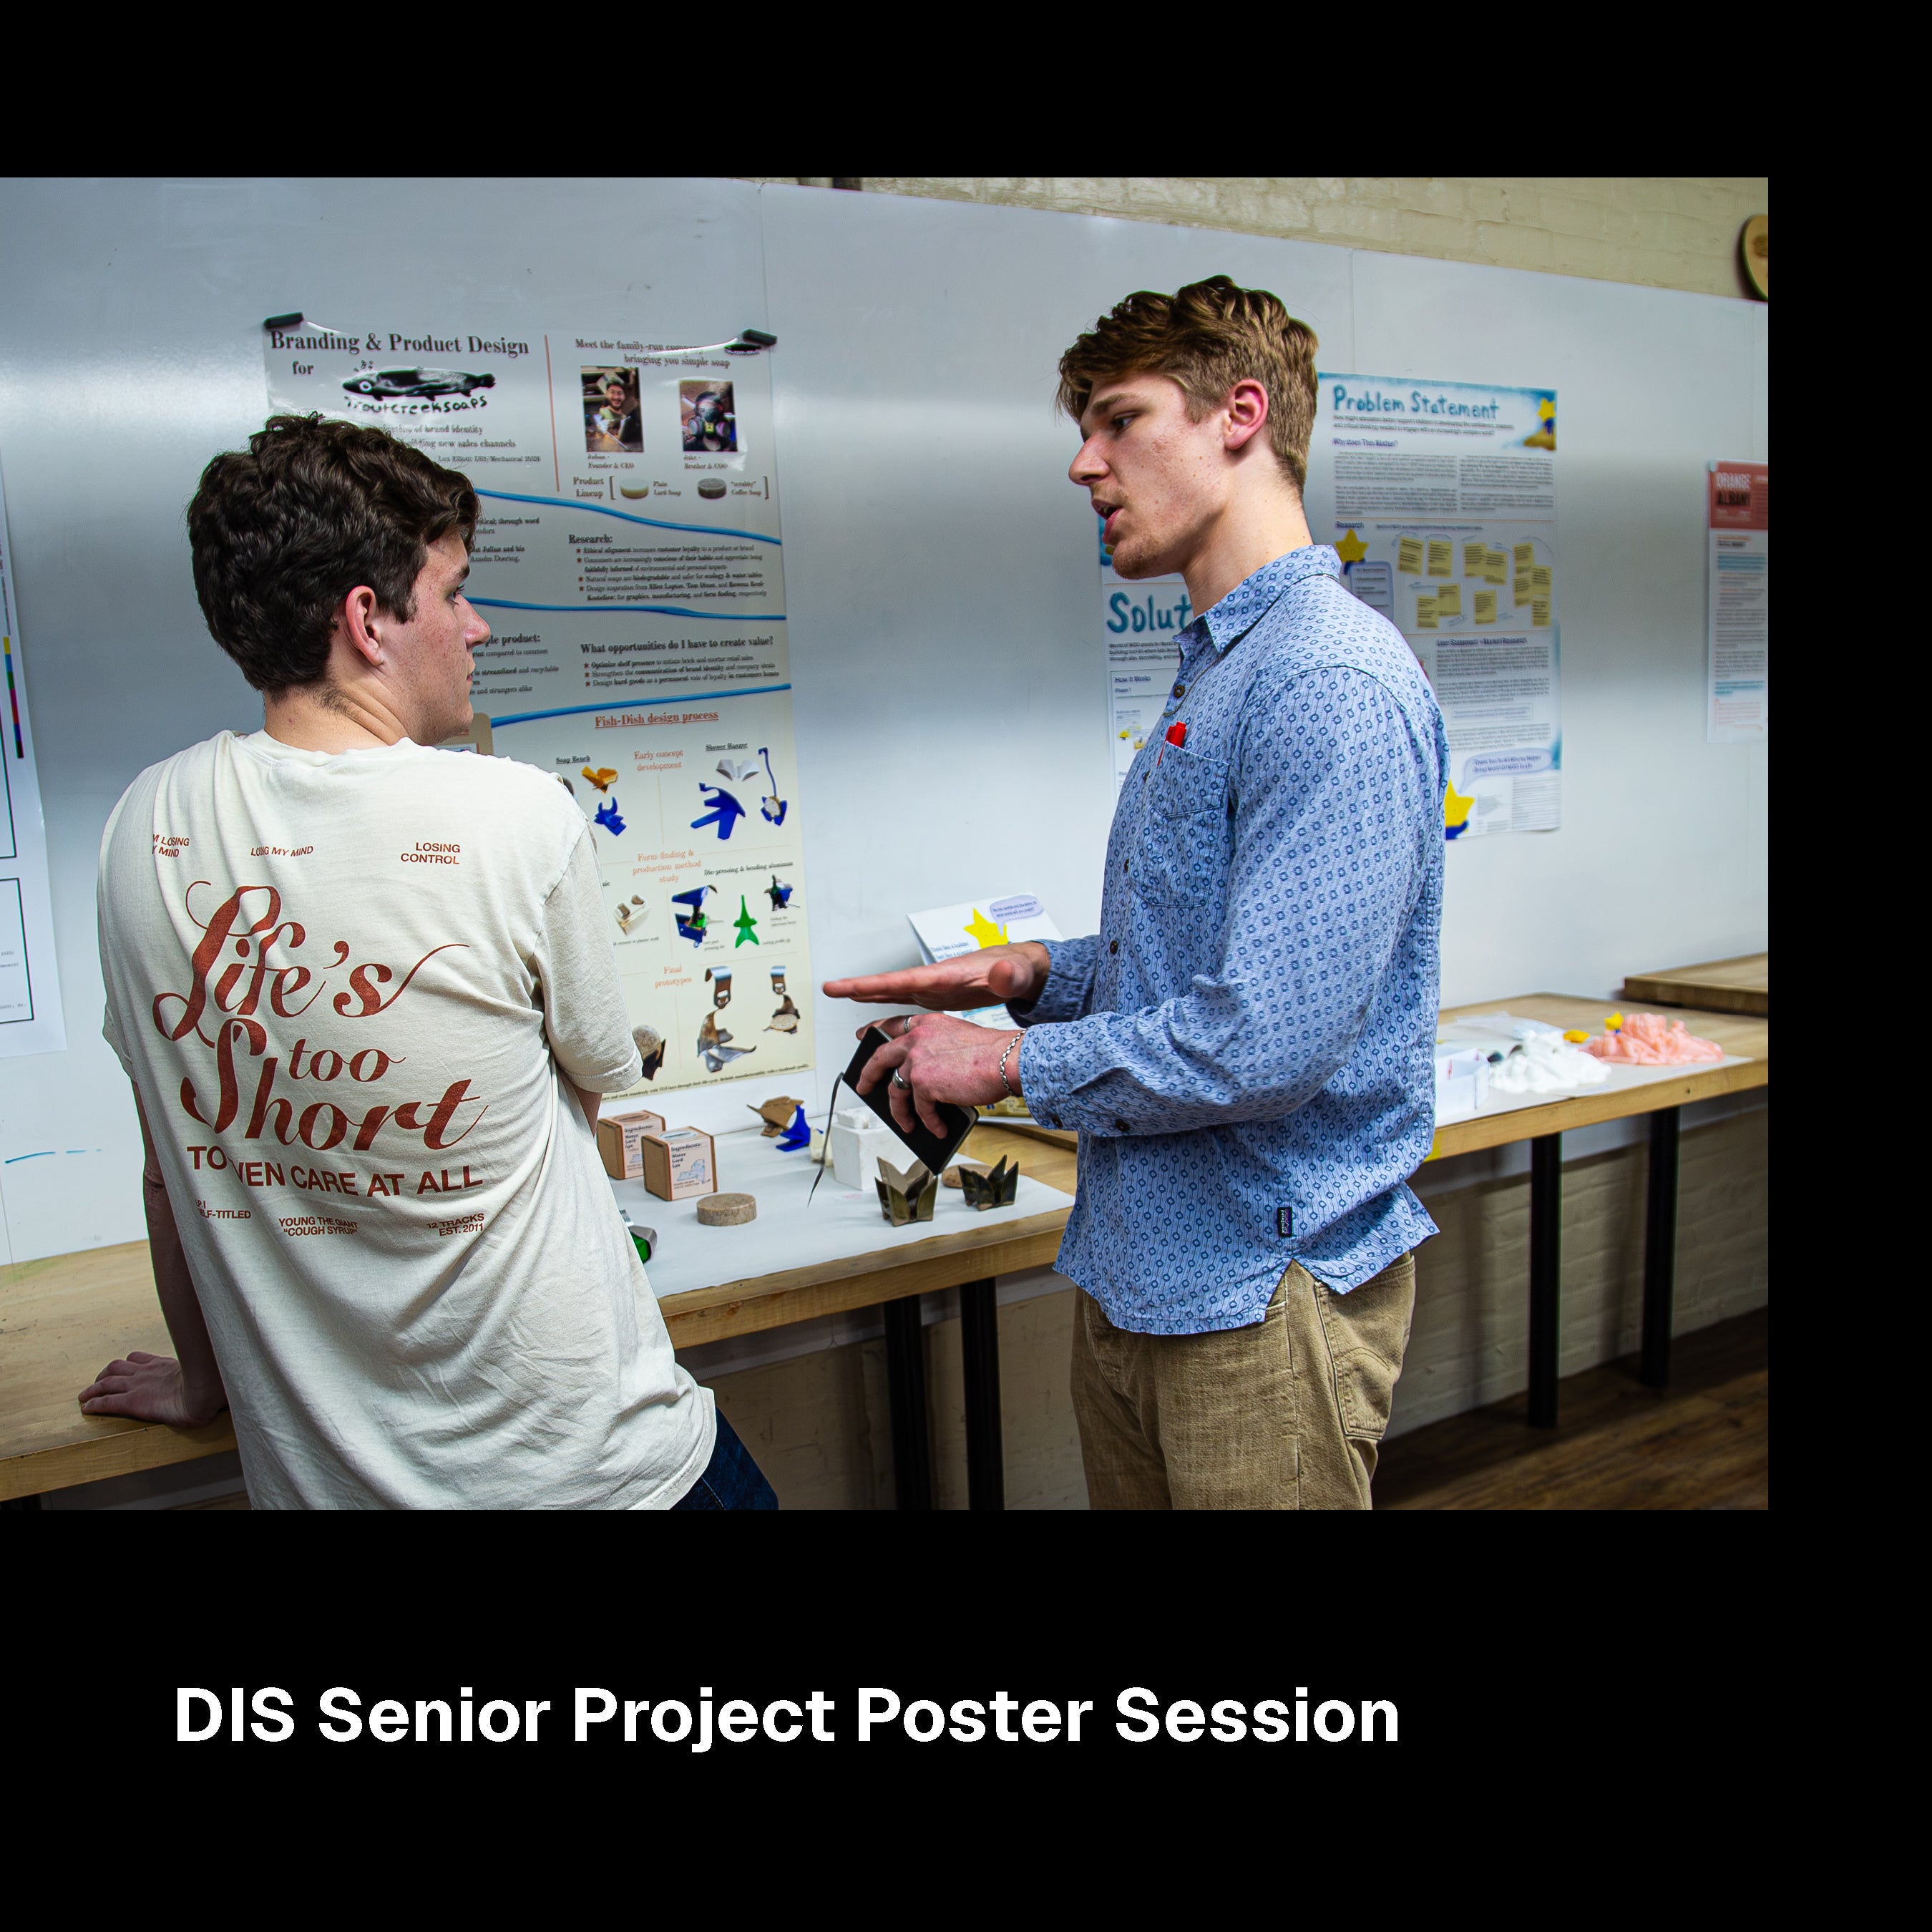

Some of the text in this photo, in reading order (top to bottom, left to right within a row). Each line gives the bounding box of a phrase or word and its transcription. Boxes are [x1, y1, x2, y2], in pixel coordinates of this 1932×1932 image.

[270, 331, 530, 358] Branding & Product Design
[575, 338, 598, 349] Meet
[600, 339, 614, 349] the
[616, 340, 664, 352] family-run
[292, 361, 314, 375] for
[624, 353, 731, 369] bringing you simple soap
[1332, 384, 1500, 419] Problem Statement
[458, 439, 479, 448] sales
[480, 439, 517, 448] channels
[572, 476, 605, 485] Product
[576, 488, 603, 499] Lineup
[568, 533, 613, 544] Research:
[1106, 591, 1194, 634] Solut
[485, 633, 541, 647] ple product:
[580, 643, 606, 653] What
[608, 640, 667, 654] opportunities
[668, 640, 679, 649] do
[688, 639, 708, 648] have
[708, 638, 718, 648] to
[719, 637, 746, 647] create
[748, 635, 774, 645] value?
[594, 711, 718, 728] Fish-Dish design process
[633, 749, 684, 761] Early concept
[636, 761, 682, 772] development
[160, 834, 190, 847] LOSING
[416, 841, 461, 854] LOSING
[159, 846, 180, 859] MIND
[271, 847, 289, 857] MY
[290, 845, 314, 857] MIND
[400, 852, 460, 865] CONTROL
[632, 859, 702, 877] production method
[658, 874, 679, 884] study
[152, 880, 471, 1049] Life's
[663, 964, 683, 975] Final
[654, 976, 693, 990] prototypes
[289, 1038, 407, 1083] too
[180, 1017, 490, 1151] Short
[186, 1145, 484, 1198] TO VEN CARE AT ALL
[198, 1209, 252, 1219] ELF-TITLED
[440, 1213, 485, 1228] TRACKS
[278, 1216, 358, 1229] YOUNG THE GIANT
[439, 1222, 484, 1236] EST. 2011
